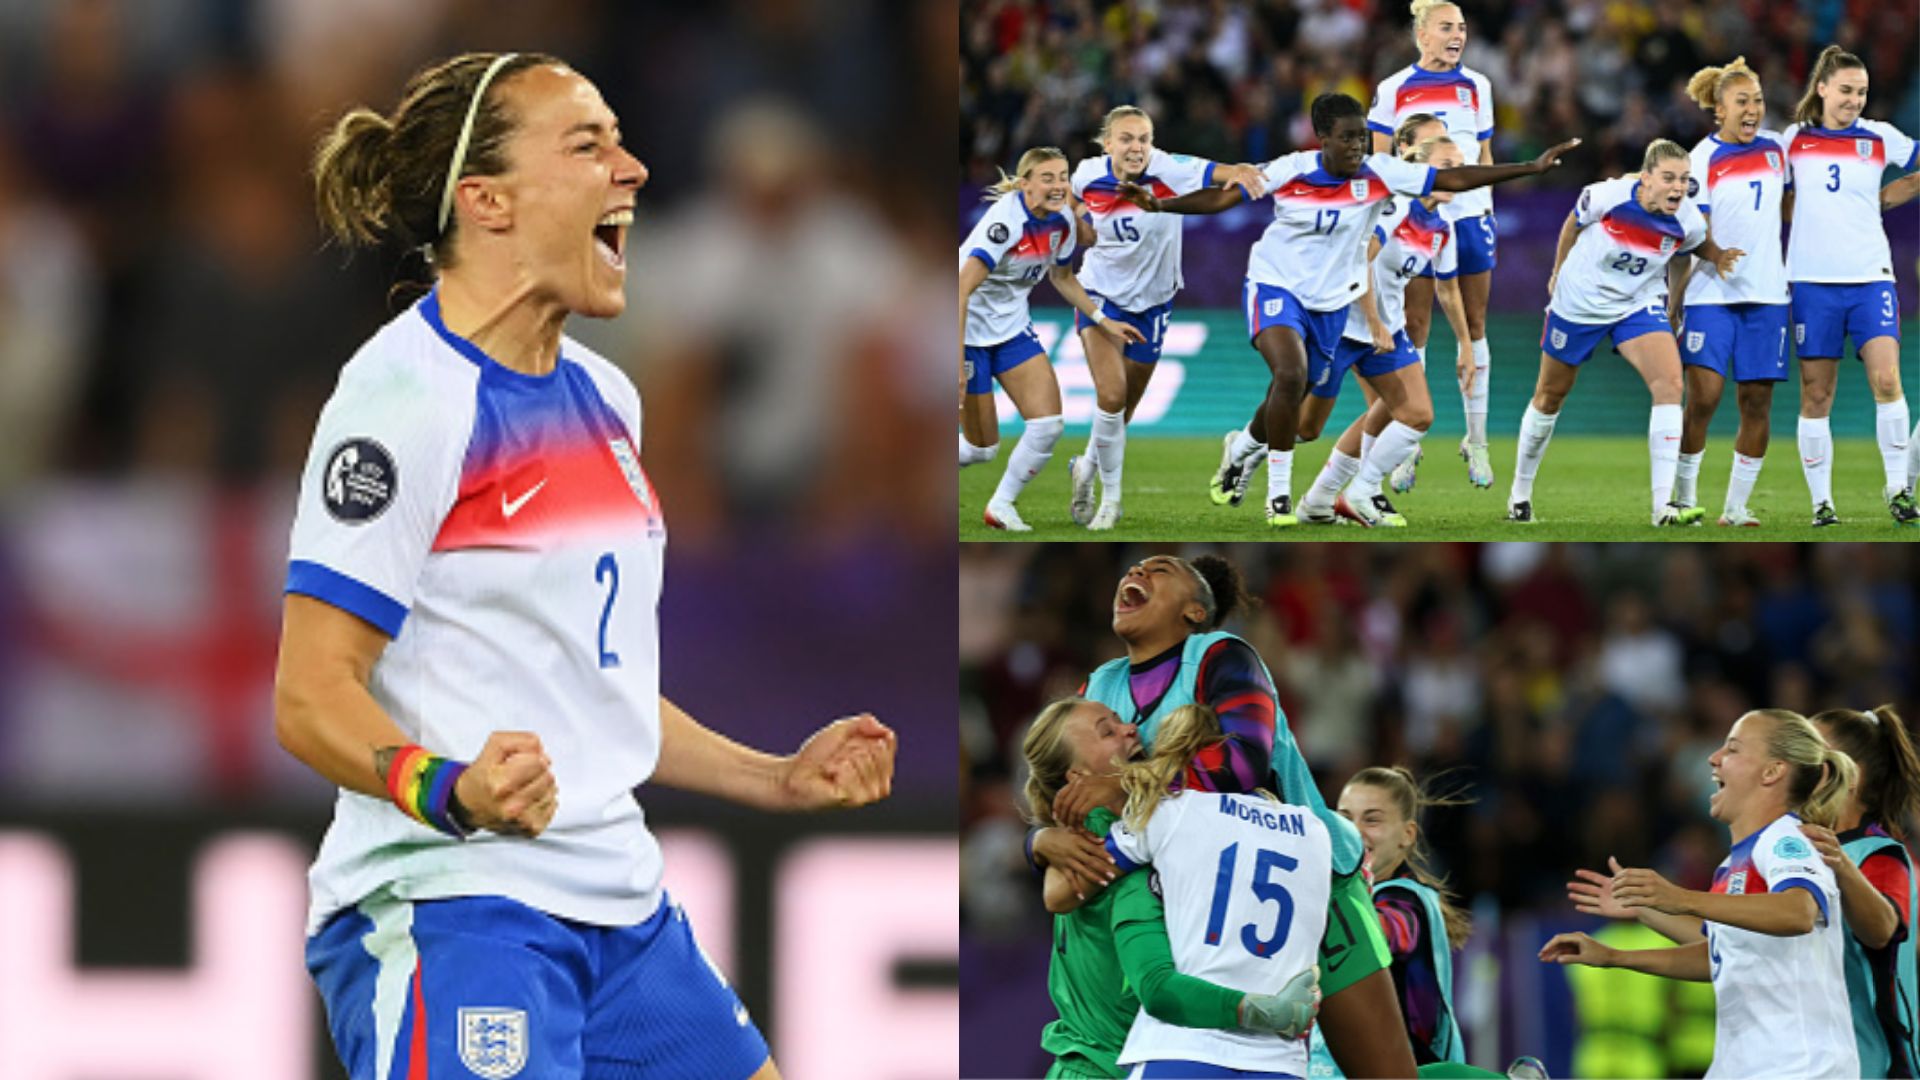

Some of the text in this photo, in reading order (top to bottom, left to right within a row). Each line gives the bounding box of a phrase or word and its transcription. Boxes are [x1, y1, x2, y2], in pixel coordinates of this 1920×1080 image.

[1826, 164, 1841, 193] 3
[1749, 181, 1763, 211] 7
[1113, 216, 1141, 242] 15
[1315, 210, 1341, 235] 17
[1612, 251, 1648, 277] 23
[595, 552, 621, 669] 2
[1219, 794, 1306, 837] MORGAN
[1204, 841, 1299, 959] 15
